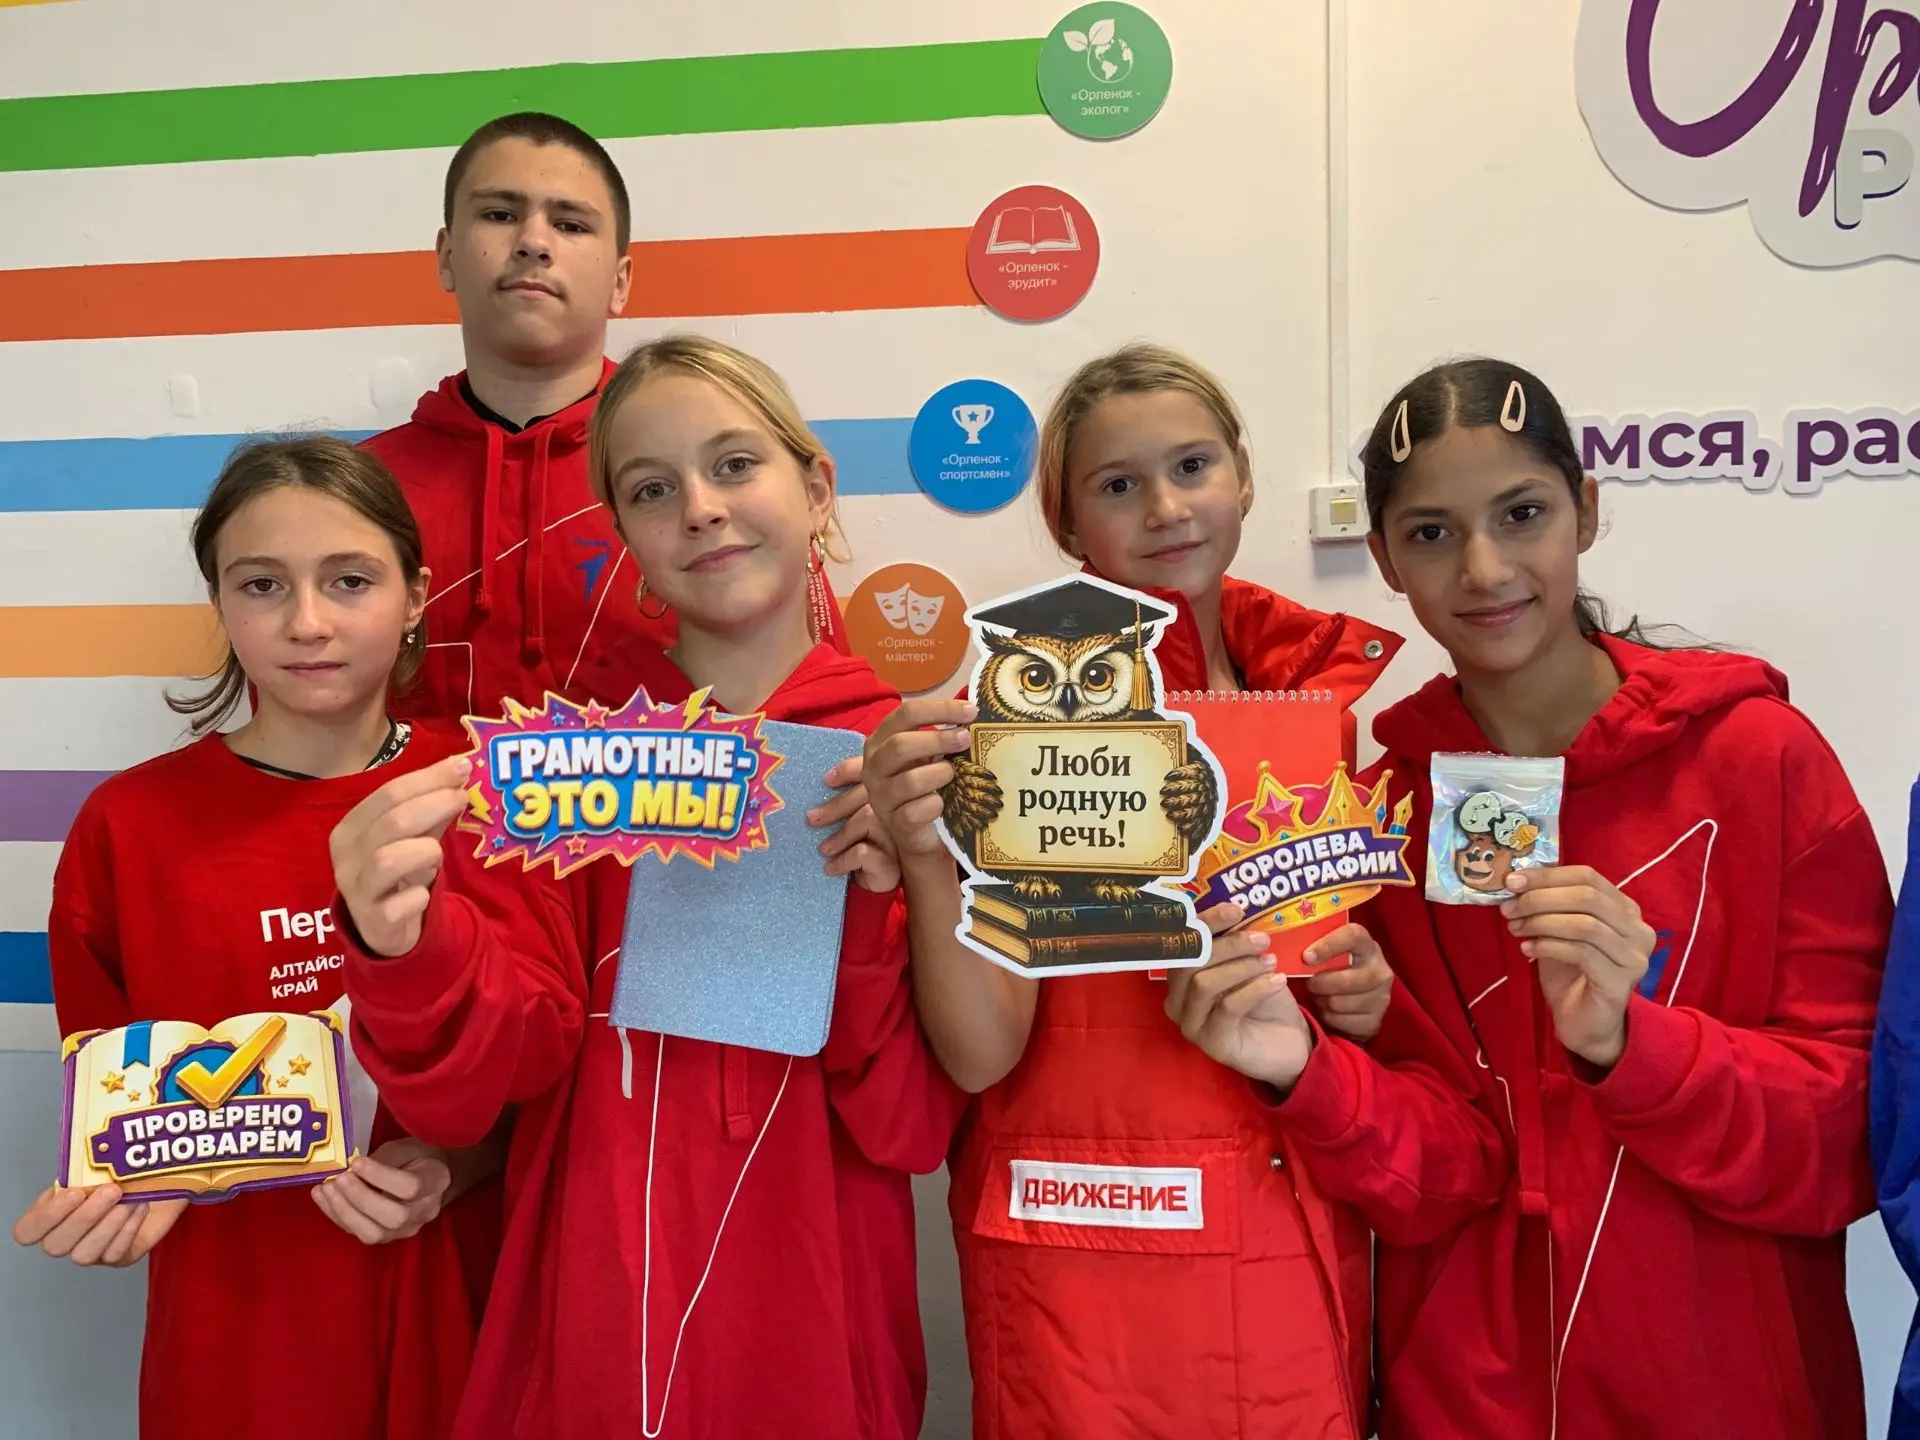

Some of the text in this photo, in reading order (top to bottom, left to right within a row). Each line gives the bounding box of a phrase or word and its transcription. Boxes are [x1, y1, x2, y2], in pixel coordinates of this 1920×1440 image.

[1071, 89, 1132, 102] «Орленок
[1080, 103, 1129, 117] эколог»
[998, 260, 1060, 275] «Орленок
[1008, 276, 1057, 290] эрудит»
[942, 453, 1001, 467] «Орленок
[1797, 418, 1920, 482] ра
[939, 469, 1010, 482] спортсмен»
[877, 636, 935, 649] «Орленок
[885, 651, 934, 663] мастер»
[497, 735, 751, 780] ГРАМОТНЫЕ-
[1030, 745, 1131, 777] Люби
[512, 780, 741, 831] ЭТО МЫ!
[1018, 785, 1147, 818] родную
[1038, 819, 1126, 853] речь!
[1221, 830, 1367, 894] КОРОЛЕВА
[1230, 850, 1398, 911] РФОГРАФИИ
[269, 954, 345, 980] АЛТАЙС
[271, 976, 319, 999] КРАЙ
[123, 1103, 302, 1142] ПРОВЕРЕНО
[125, 1126, 302, 1169] СЛОВАРЁМ
[1022, 1178, 1188, 1212] ДВИЖЕНИЕ
